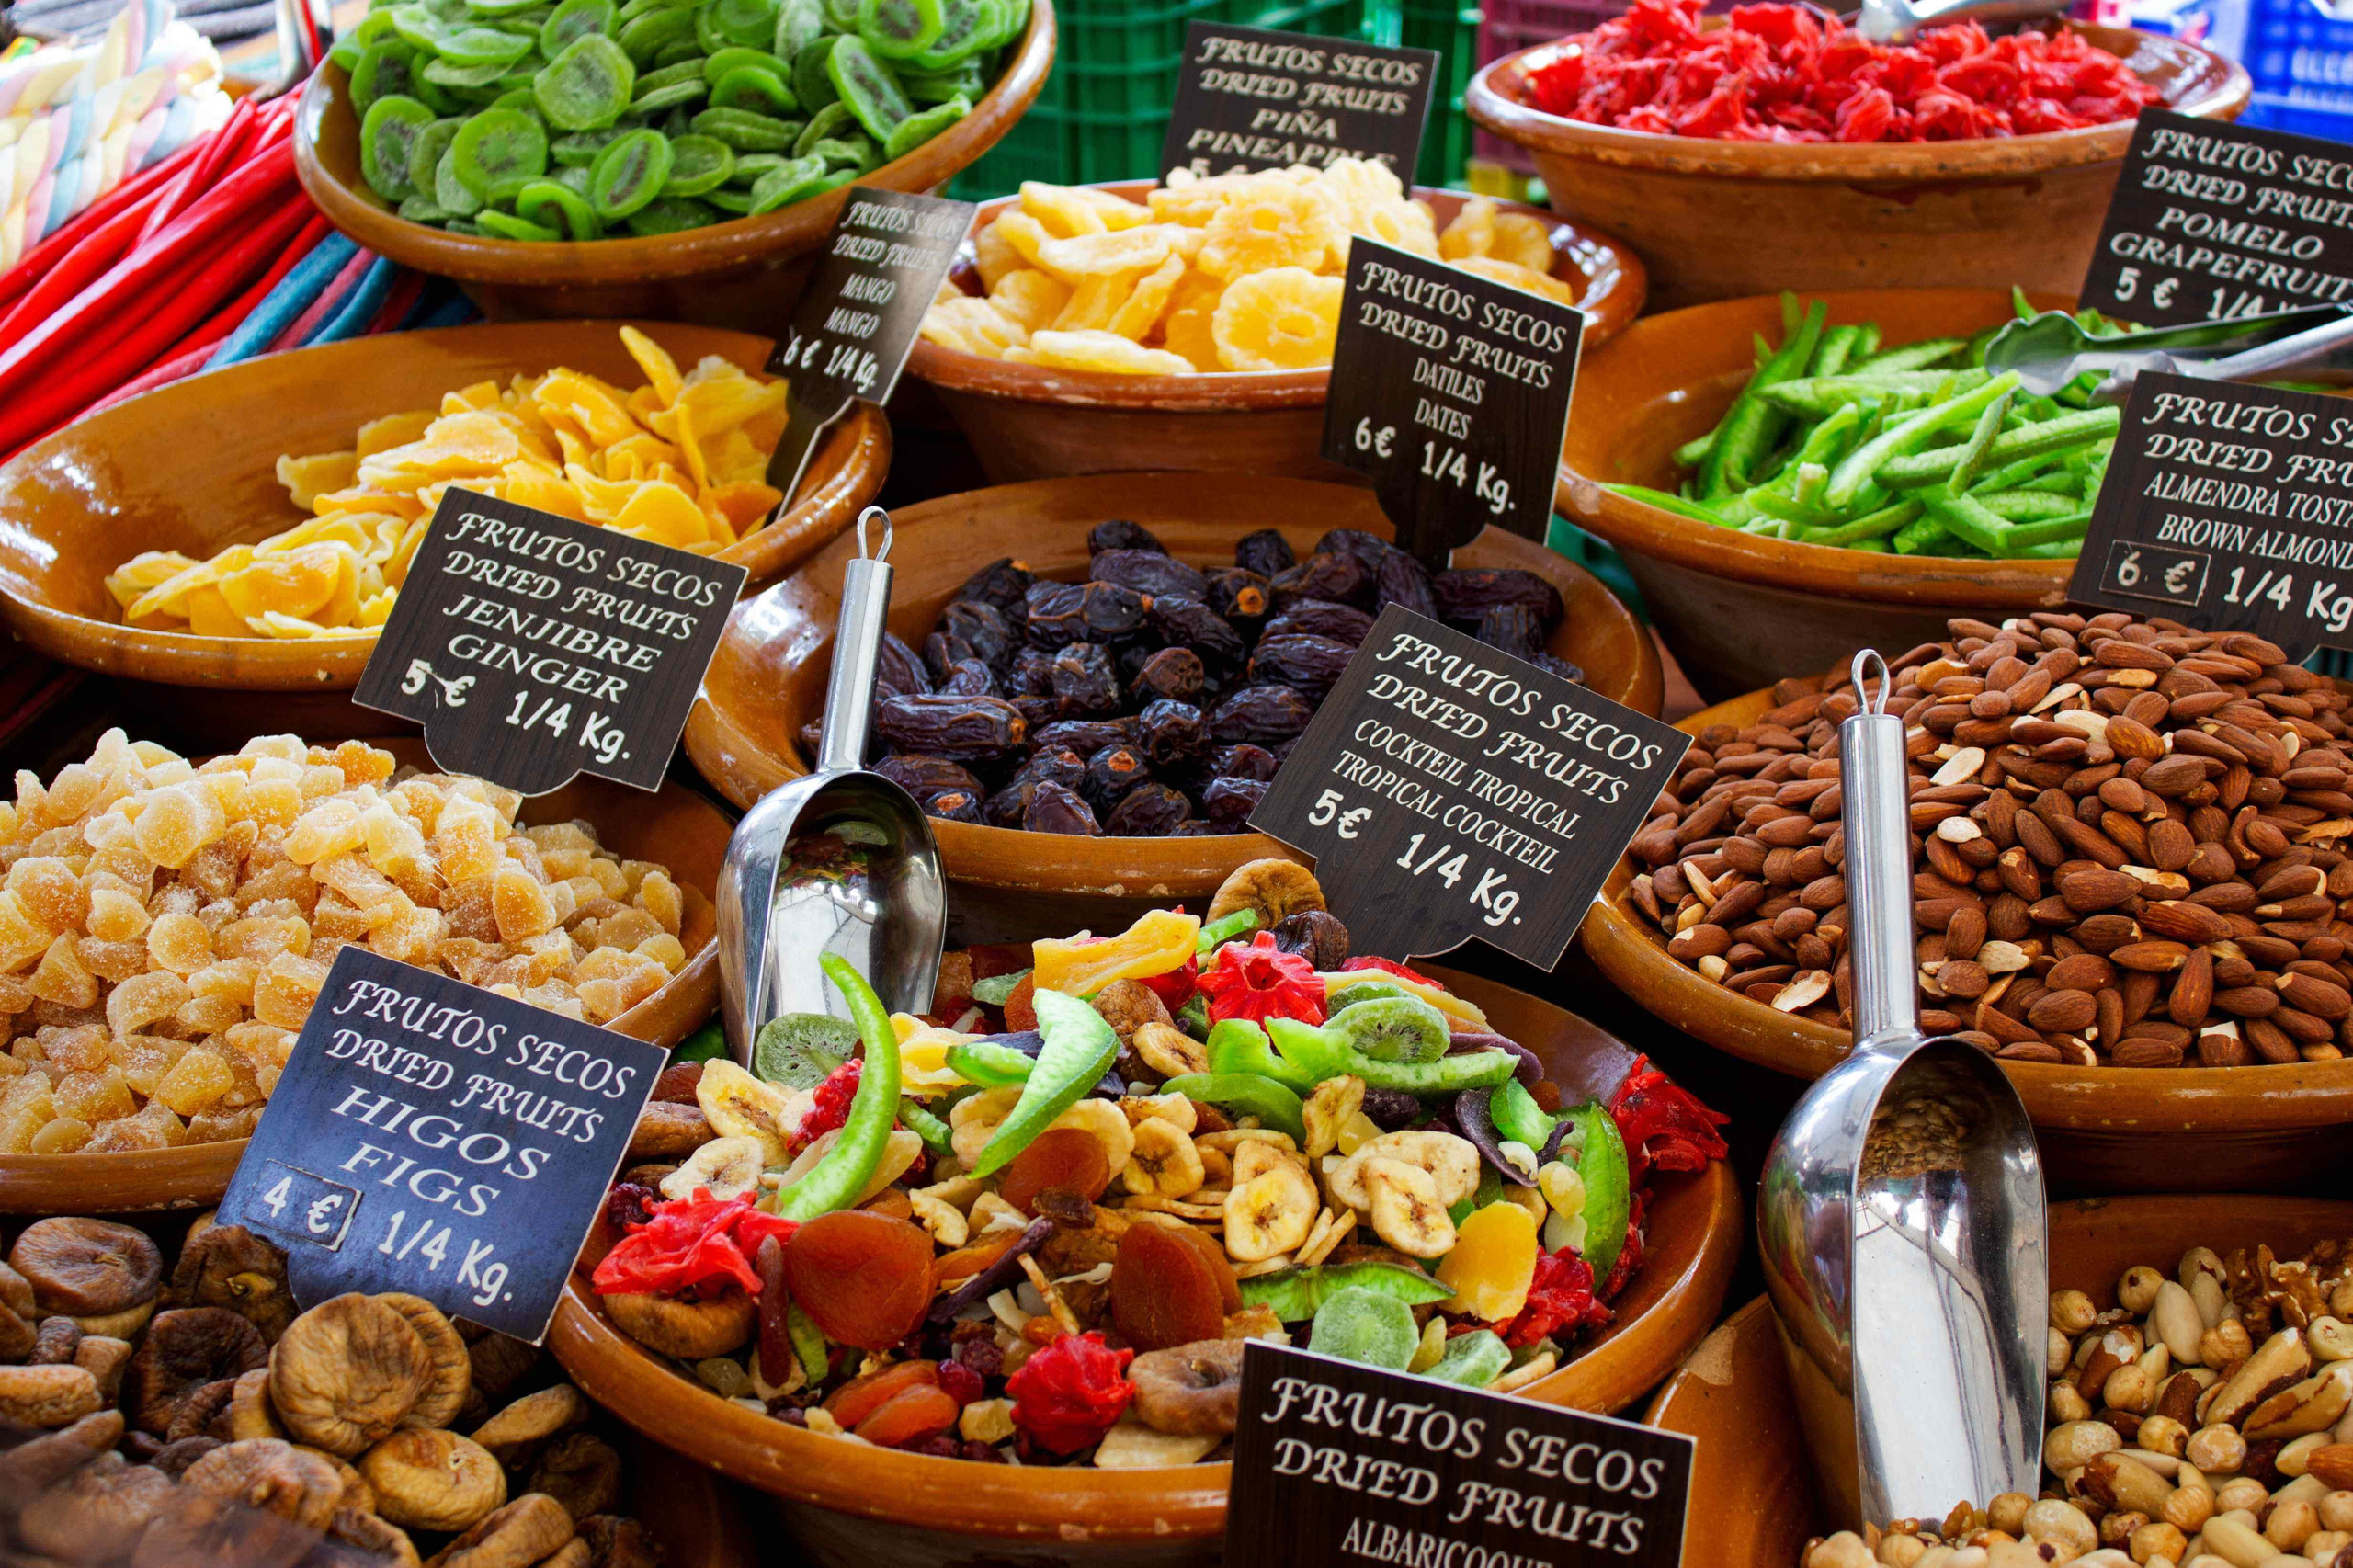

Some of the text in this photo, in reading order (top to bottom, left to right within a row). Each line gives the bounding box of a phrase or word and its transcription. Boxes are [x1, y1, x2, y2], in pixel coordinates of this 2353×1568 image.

[1195, 37, 1424, 86] FRUTOS SECOS
[1199, 68, 1410, 115] DRIED FRUITS
[1251, 108, 1337, 140] PIÑA
[2141, 128, 2284, 176] FRUTOS
[840, 201, 911, 232] FRUTOS
[2141, 165, 2353, 230] DRIED FRUIT
[2156, 207, 2324, 260] POMELO
[832, 233, 886, 262] DRIED
[824, 306, 881, 339] MANGO
[839, 273, 897, 304] MANGO
[1356, 261, 1566, 353] FRUTOS SECOS
[2115, 266, 2141, 301] 5
[2152, 278, 2180, 309] €
[1360, 301, 1552, 389] DRIED FRUITS
[1413, 357, 1486, 405] DATILES
[1415, 397, 1472, 440] DATES
[2141, 392, 2317, 440] FRUTOS
[1421, 440, 1468, 488] 1/4
[1475, 461, 1516, 514] Kg.
[2144, 433, 2274, 473] DRIED
[2143, 471, 2280, 517] ALMENDRA
[445, 512, 722, 608] FRUTOS SECOS
[2156, 513, 2254, 552] BROWN
[442, 551, 698, 641] DRIED FRUITS
[2164, 560, 2196, 594] €
[2223, 566, 2293, 611] 1/4
[443, 594, 662, 673] JENJIBRE
[448, 634, 629, 704] GINGER
[505, 690, 573, 737] 1/4
[579, 711, 631, 765] Kg.
[1375, 632, 1662, 772] FRUTOS SECOS
[1367, 673, 1629, 805] DRIED FRUITS
[1331, 749, 1560, 875] TROPICAL COCKTEIL
[1354, 718, 1581, 840] COCKTEIL TROPICAL
[1396, 833, 1469, 890] 1/4
[1469, 867, 1522, 927] Kg.
[333, 980, 637, 1099] FRUTOS SECOS
[325, 1028, 605, 1144] DRIED FRUITS
[330, 1085, 551, 1180] HIGOS
[338, 1141, 501, 1218] FIGS
[263, 1176, 513, 1308] 4 € 1/4 Kg.
[1260, 1376, 1666, 1500] FRUTOS SECOS
[1272, 1437, 1644, 1555] DRIED FRUITS
